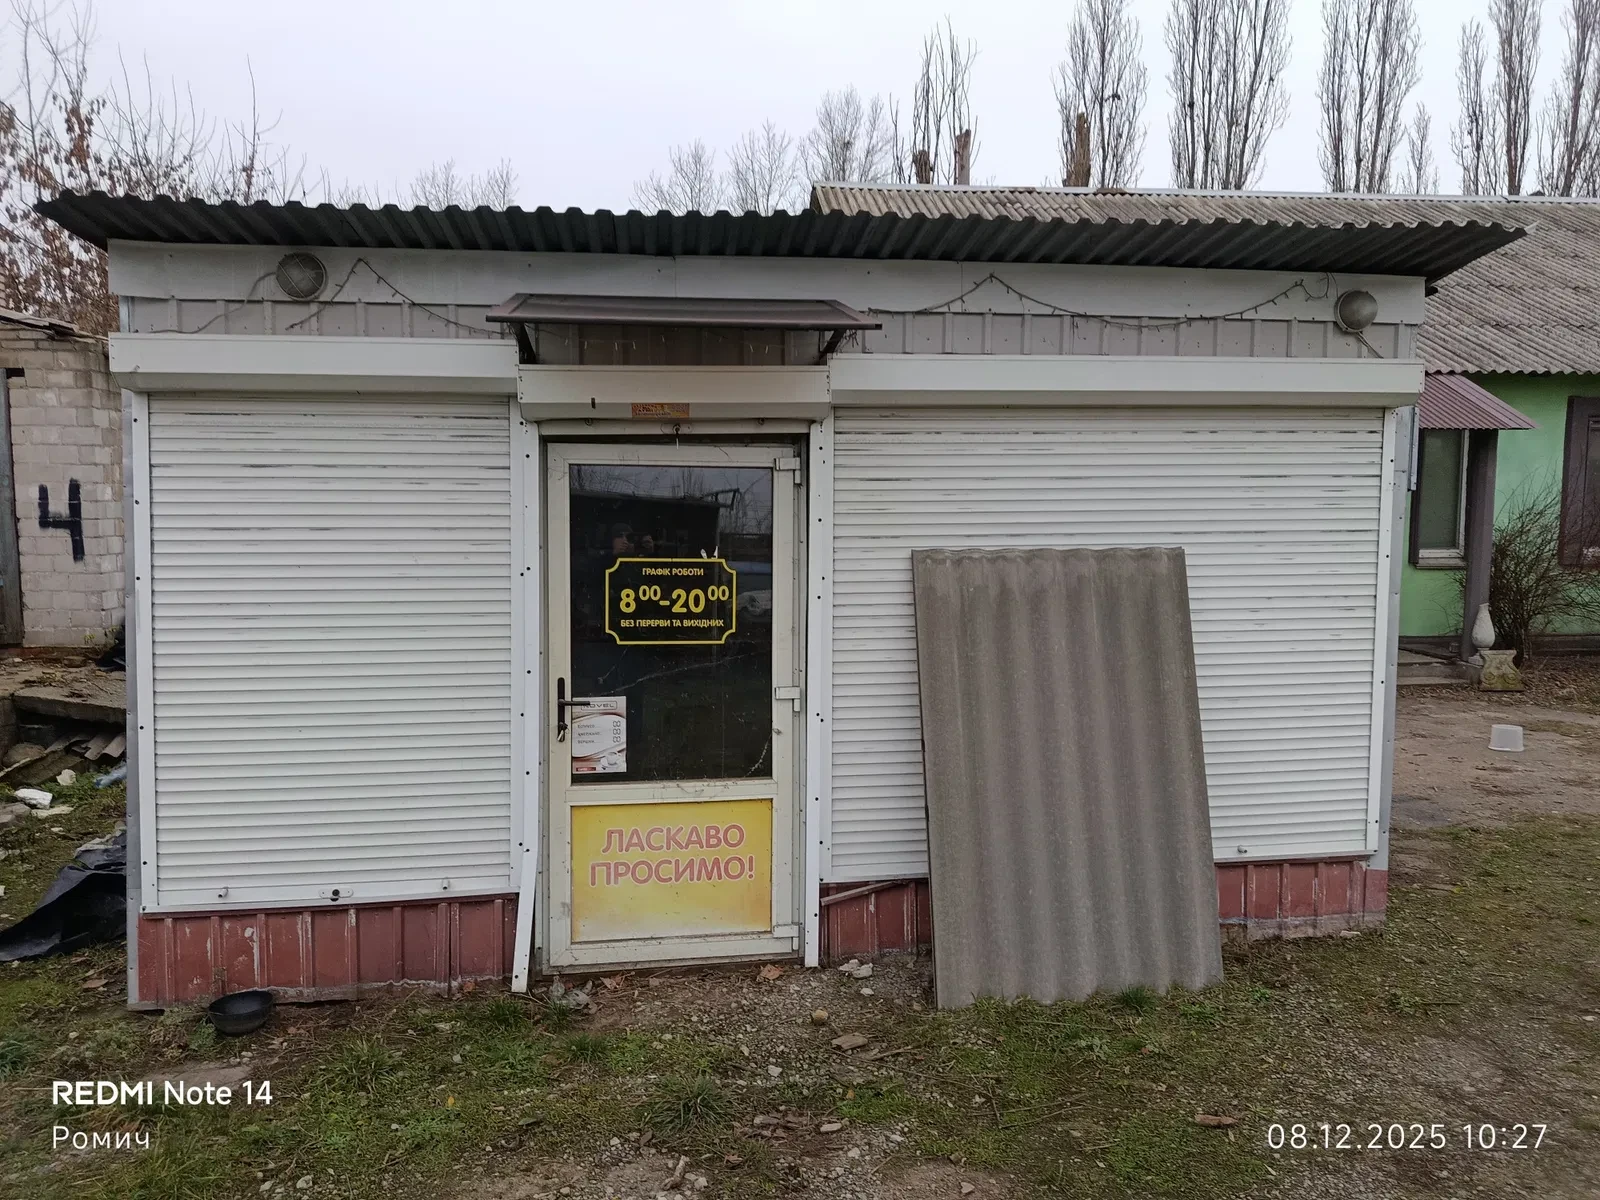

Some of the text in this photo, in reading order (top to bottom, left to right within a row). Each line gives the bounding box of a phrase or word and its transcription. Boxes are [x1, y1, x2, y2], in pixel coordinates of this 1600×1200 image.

[642, 567, 704, 576] ГРАФІК РОБОТИ
[620, 619, 725, 628] БЕЗ ПЕРЕРВИ ТА ВИХІДНИХ
[601, 824, 745, 854] ЛАСКАВО
[590, 855, 754, 887] ПРОСИМО!
